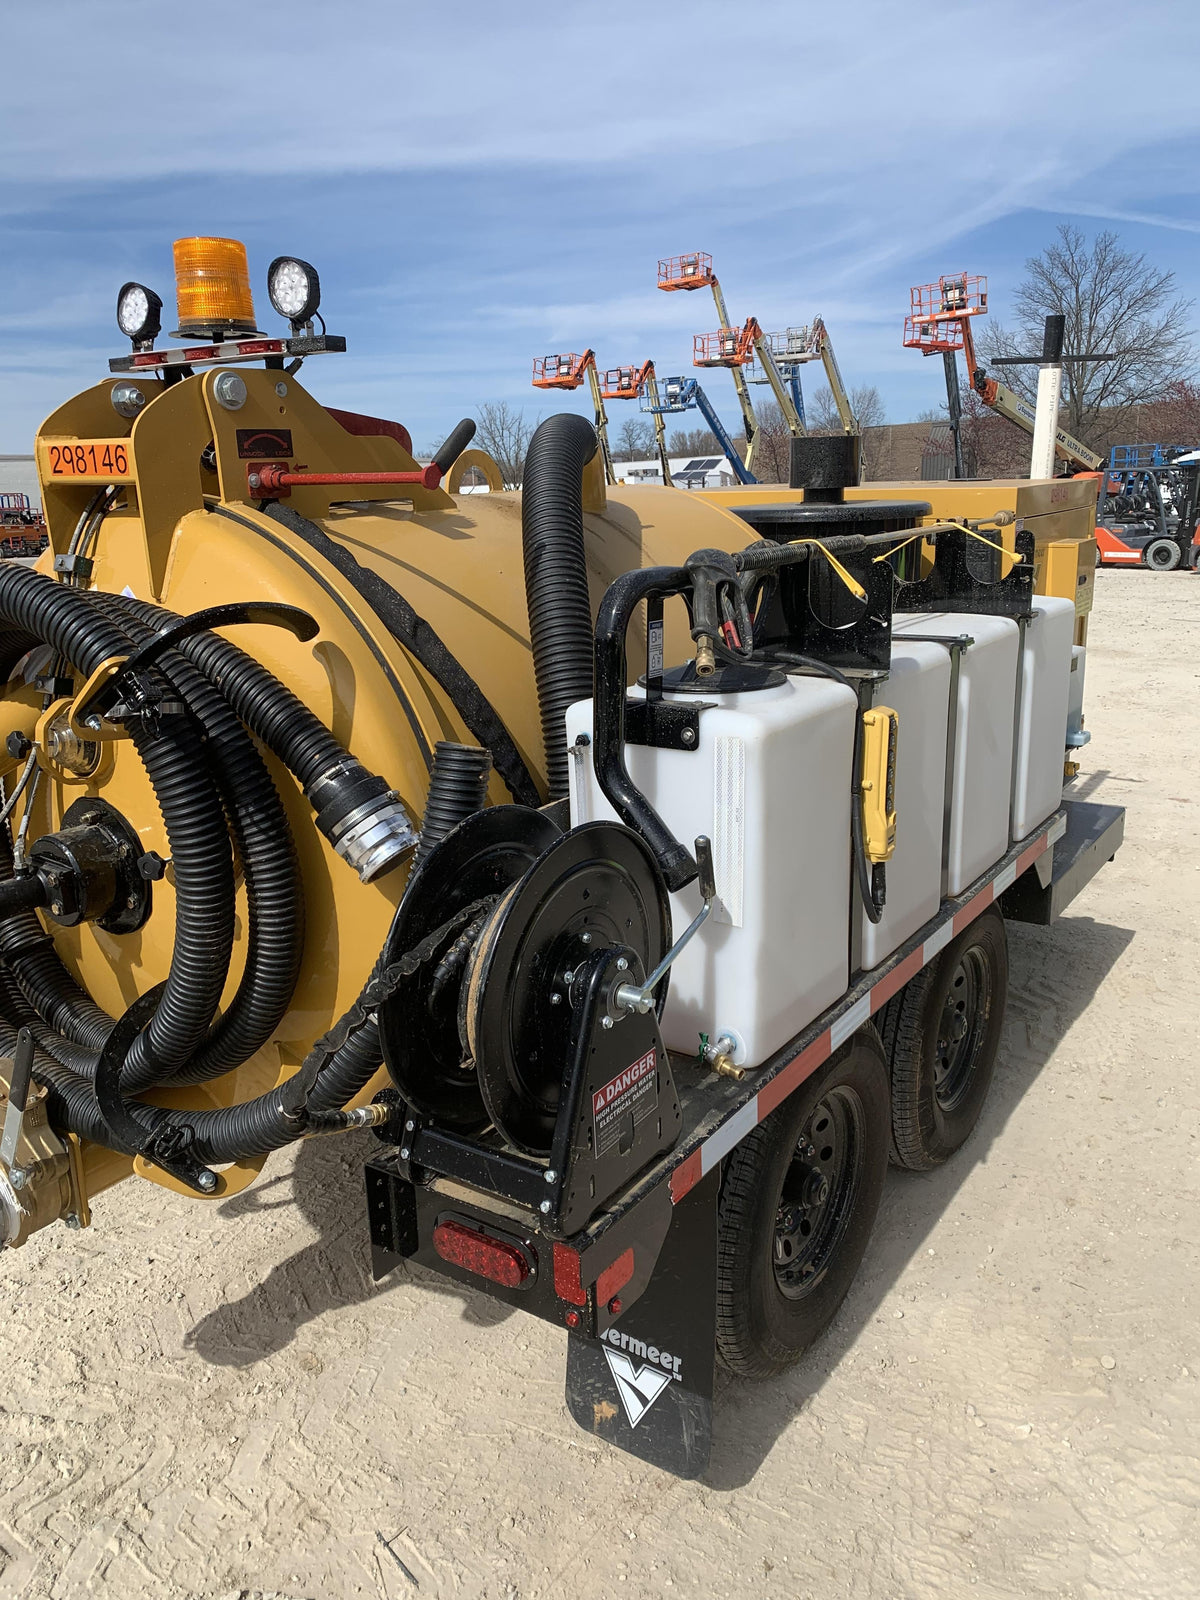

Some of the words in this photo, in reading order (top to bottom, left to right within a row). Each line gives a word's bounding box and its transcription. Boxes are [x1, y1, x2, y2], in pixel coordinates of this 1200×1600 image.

[50, 444, 127, 474] 298146
[1066, 440, 1081, 456] ULTRA
[1080, 450, 1094, 464] BOOM
[596, 1105, 610, 1122] HIGH
[610, 1084, 638, 1111] PRESSURE
[638, 1069, 656, 1088] WATER
[606, 1052, 655, 1102] DANGER
[600, 1099, 632, 1129] ELECTRICAL
[632, 1080, 653, 1102] DANGER
